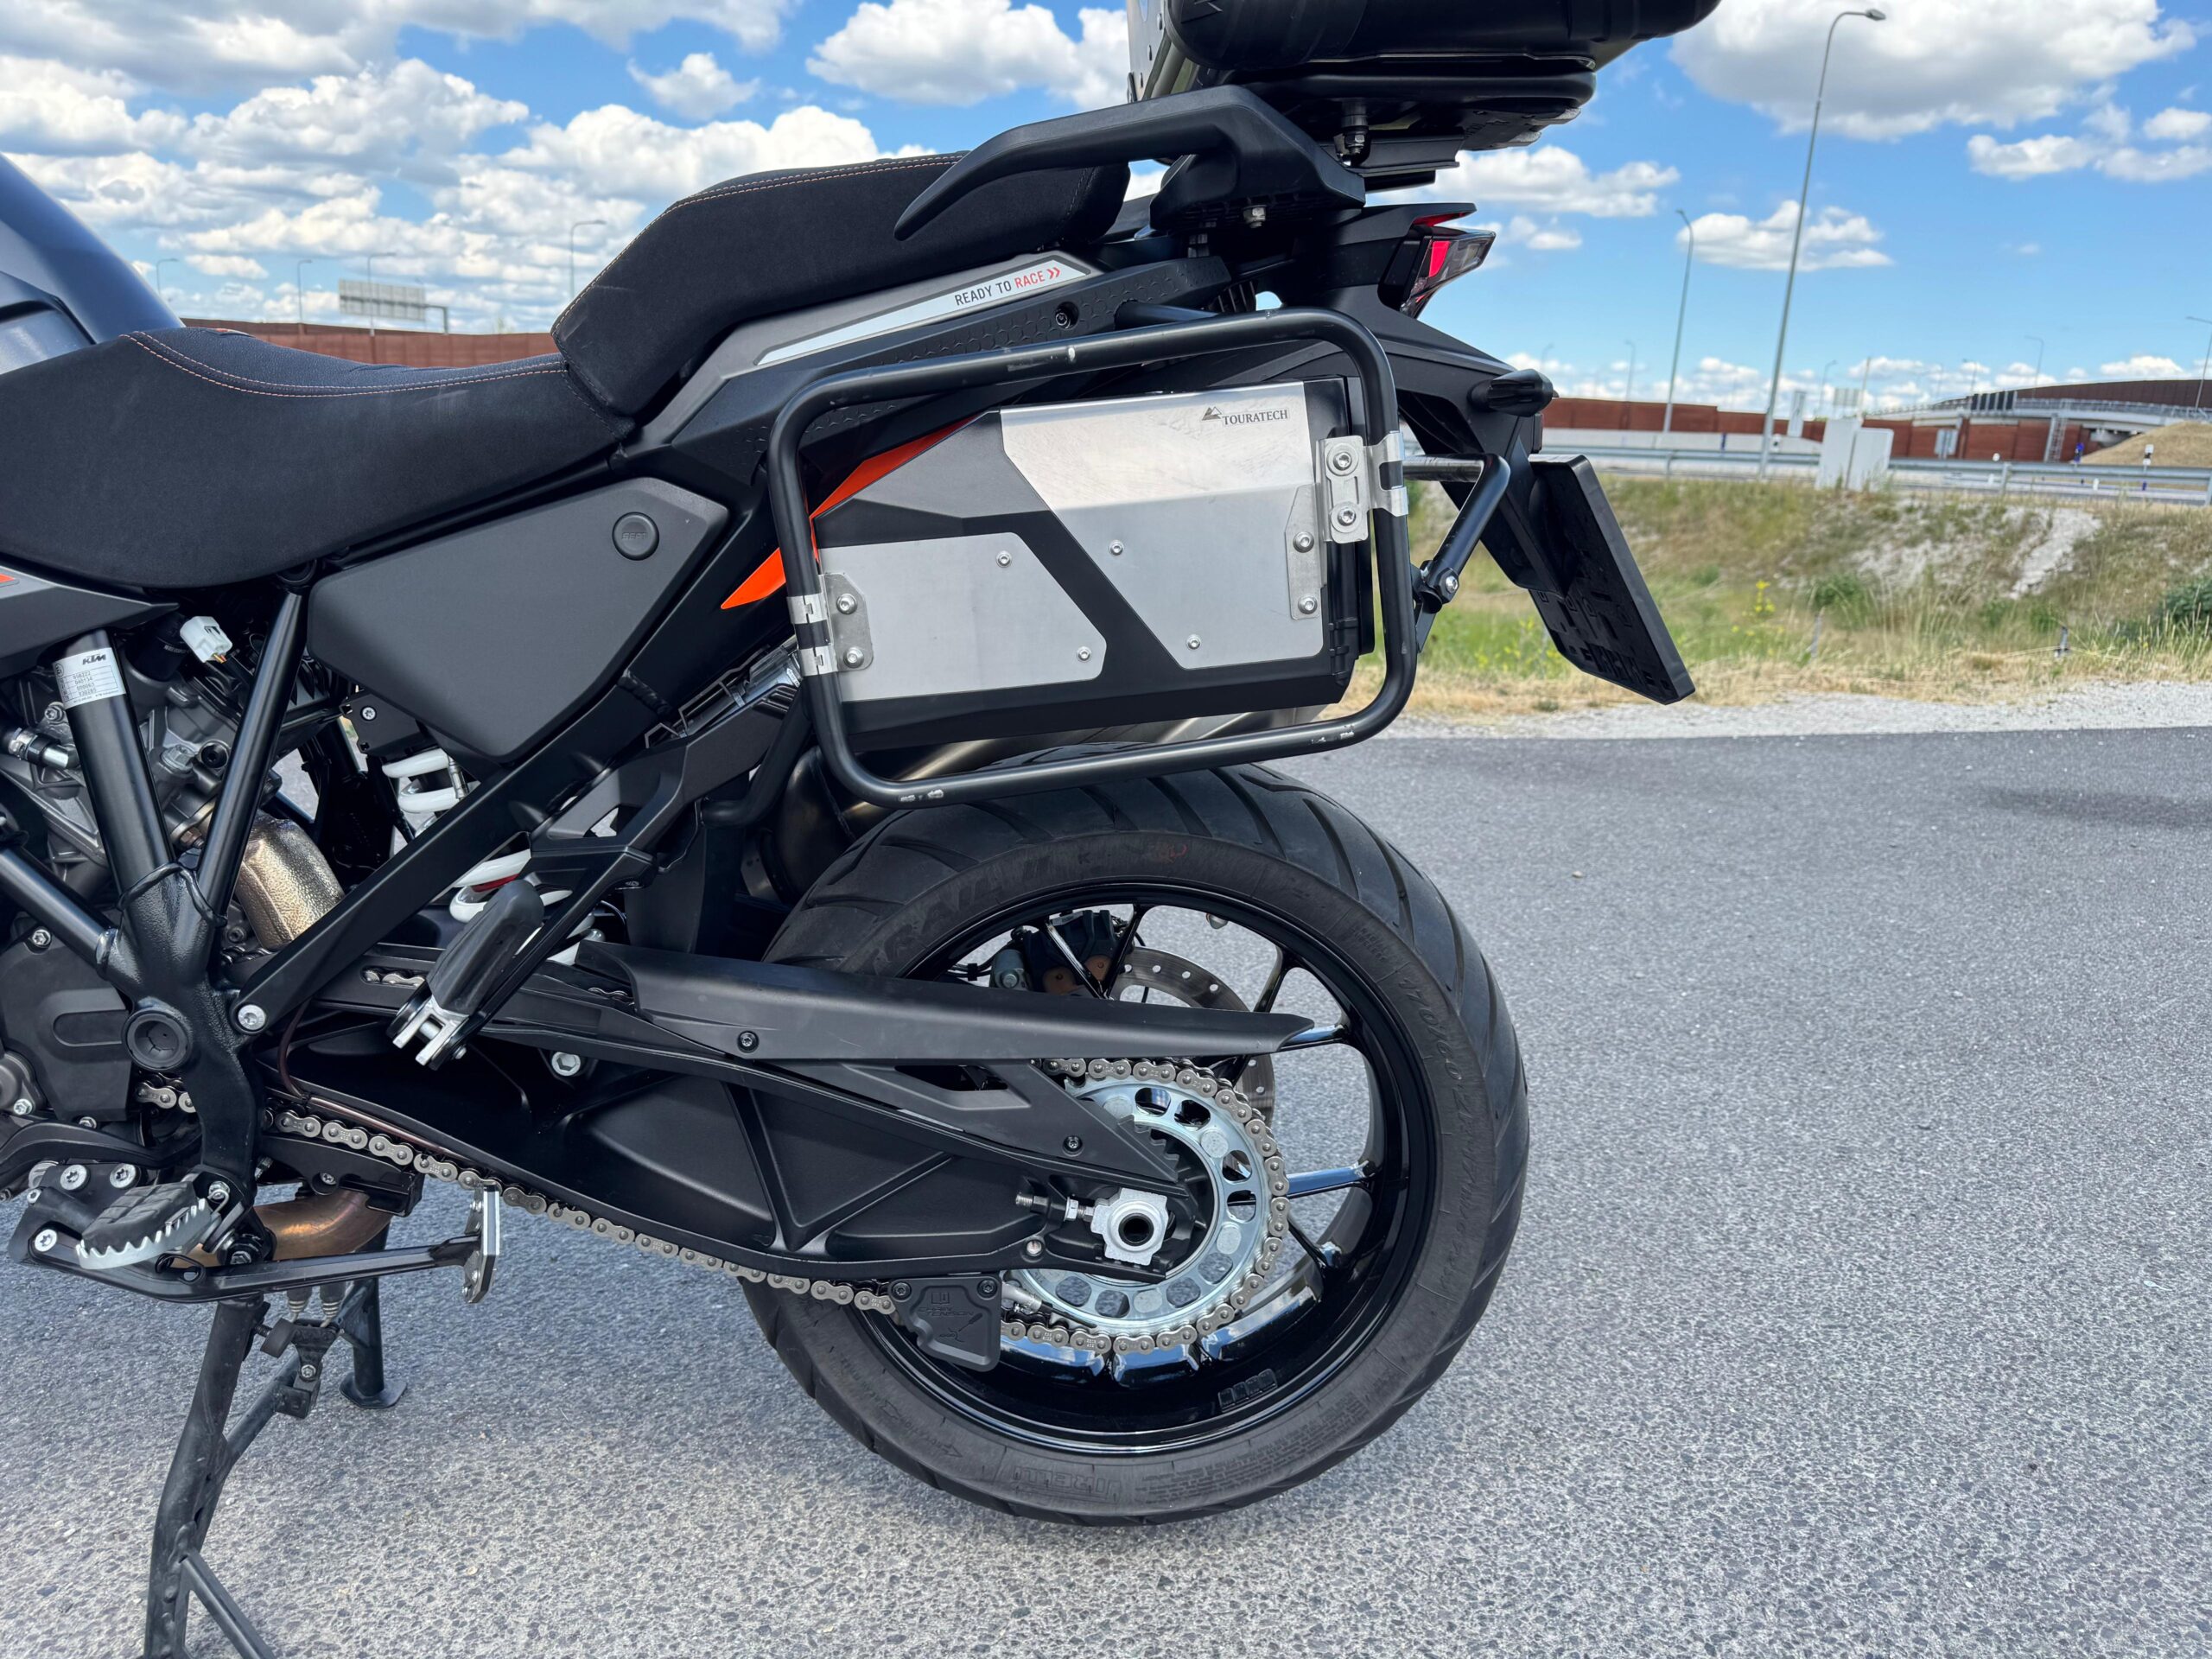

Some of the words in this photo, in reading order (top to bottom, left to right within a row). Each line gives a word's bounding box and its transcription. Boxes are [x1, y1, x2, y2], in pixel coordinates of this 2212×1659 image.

[955, 285, 993, 306] READY
[995, 280, 1012, 294] TO
[1014, 270, 1046, 289] RACE
[1223, 410, 1288, 425] TOURATECH
[82, 654, 106, 665] KTM
